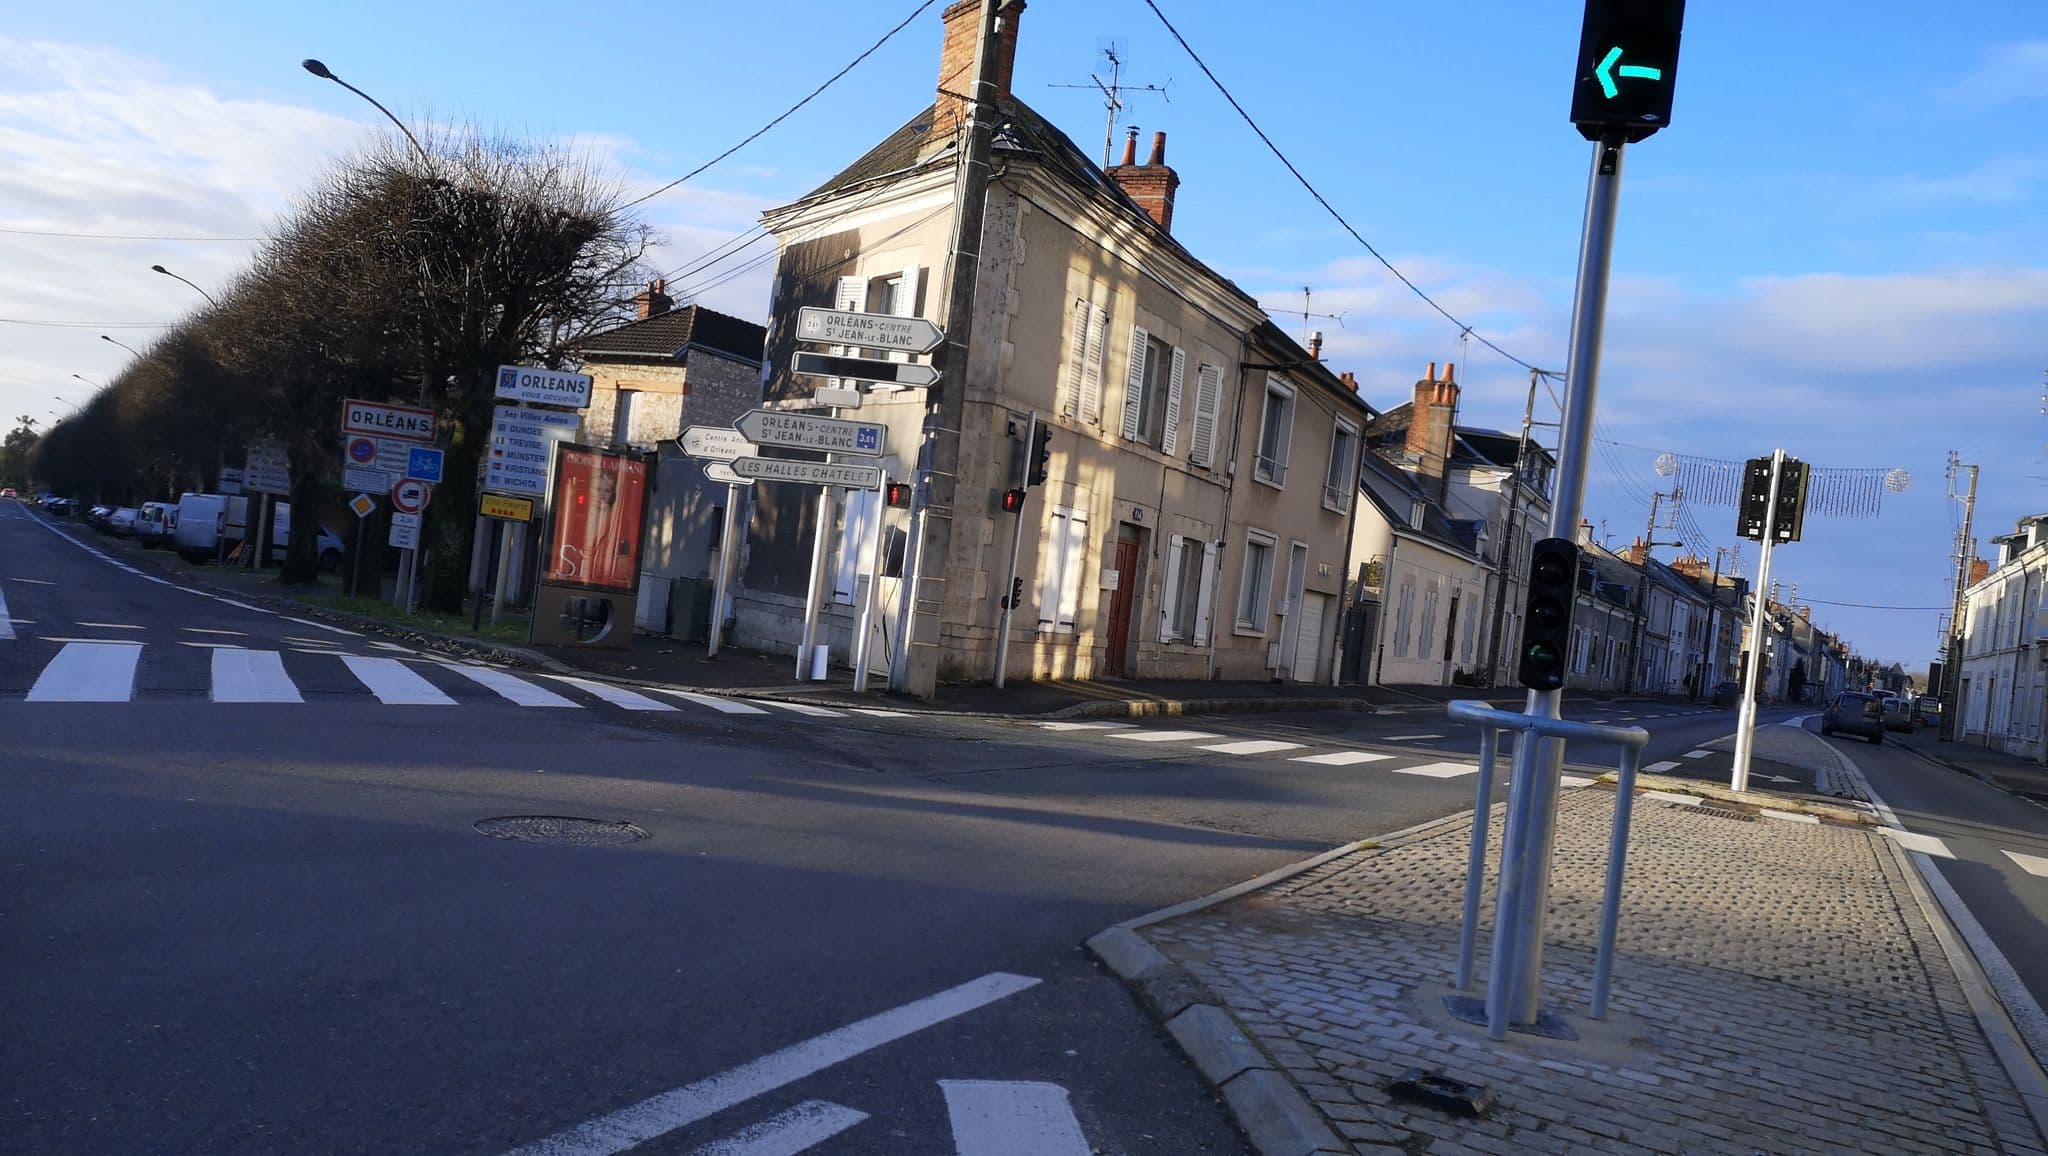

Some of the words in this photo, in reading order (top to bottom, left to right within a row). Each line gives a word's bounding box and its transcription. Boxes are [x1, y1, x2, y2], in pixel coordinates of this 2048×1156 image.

[838, 329, 912, 346] JEAN-LE-BLANC
[521, 374, 586, 394] ORLEANS
[522, 391, 541, 399] vous
[352, 410, 430, 432] ORLÉANS
[504, 409, 516, 419] Ses
[520, 411, 541, 421] Villes
[543, 415, 568, 425] Amies
[510, 425, 544, 436] DUNDEE
[705, 433, 727, 442] Centre
[509, 438, 542, 450] TREVISE
[774, 430, 853, 448] JEAN-LE-BLANC
[507, 451, 546, 463] MUNSTER
[741, 461, 760, 473] LES
[765, 463, 807, 477] HALLES
[812, 466, 873, 482] CHATELET
[504, 477, 537, 489] WICHITA
